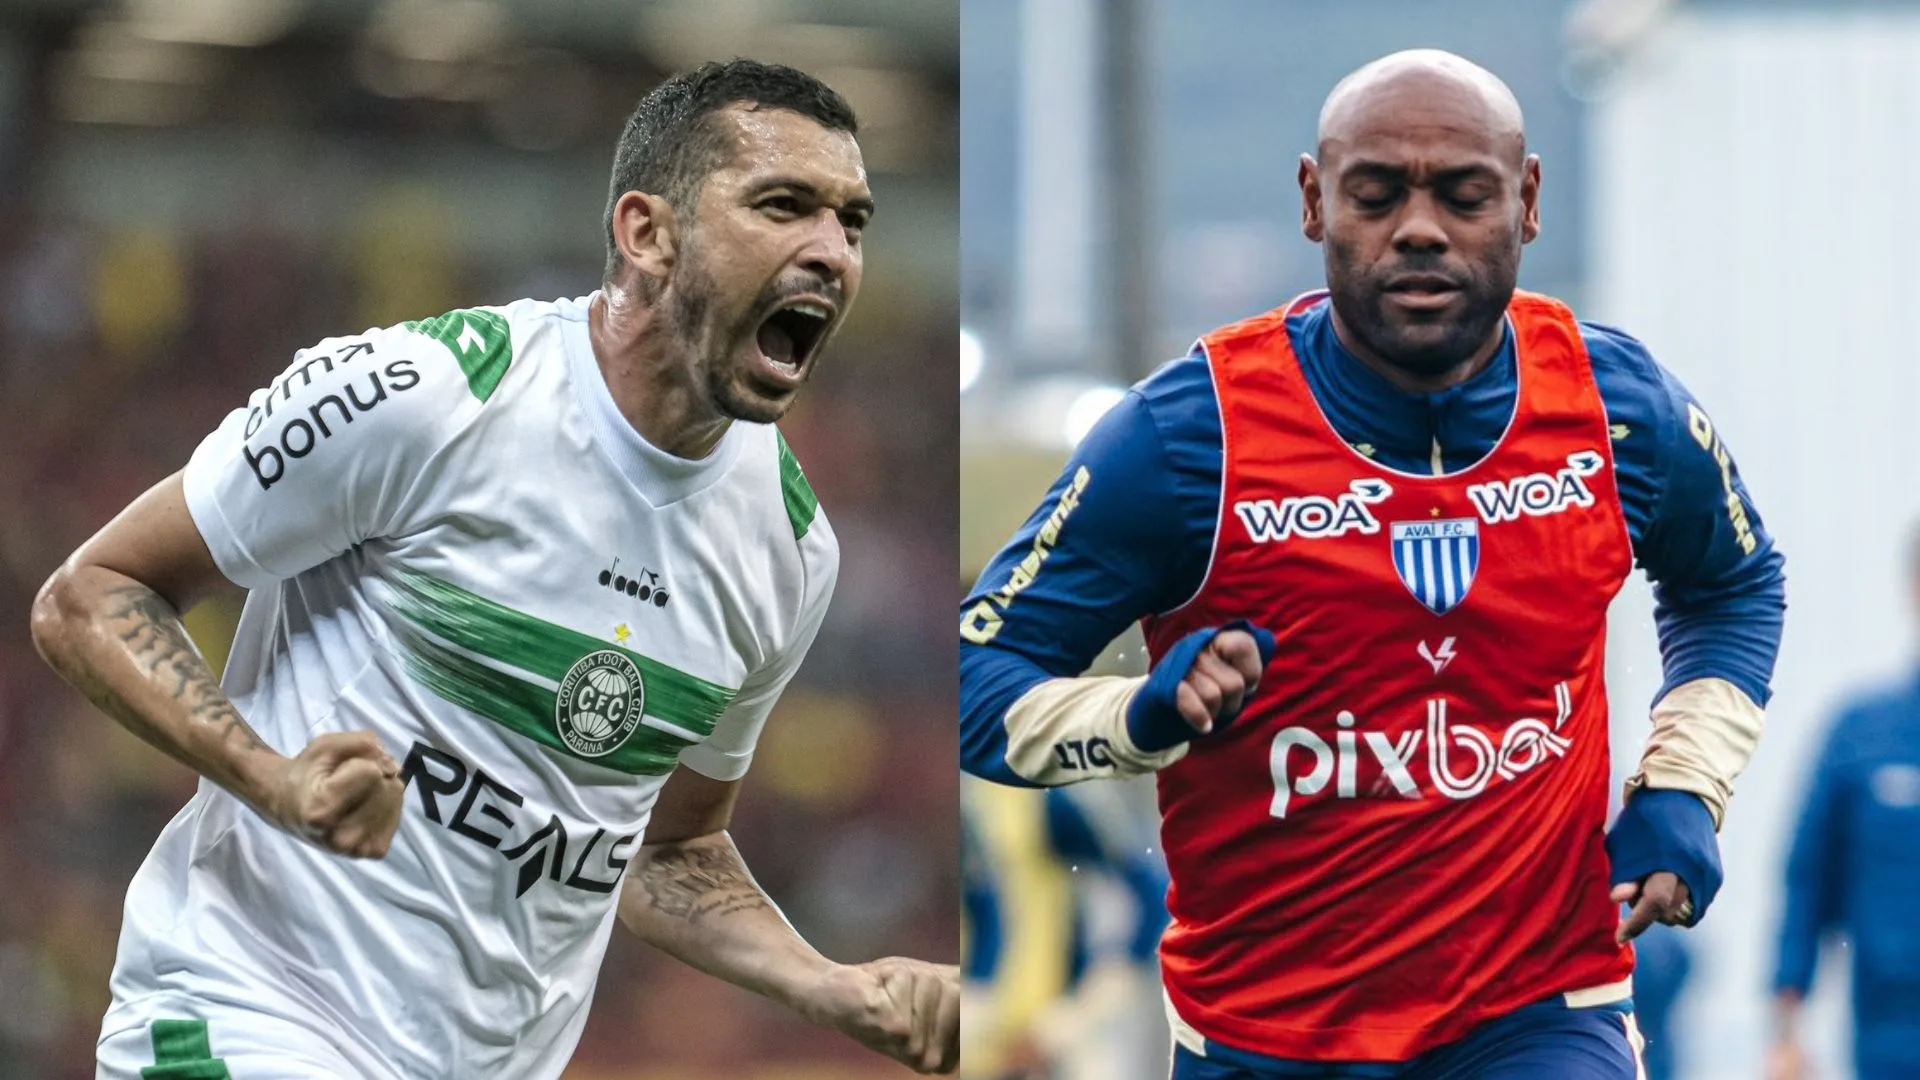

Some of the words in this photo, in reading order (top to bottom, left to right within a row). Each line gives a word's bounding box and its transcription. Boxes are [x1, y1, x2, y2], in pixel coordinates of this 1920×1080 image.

[242, 359, 420, 491] bonus
[1240, 498, 1376, 538] WOA
[1473, 472, 1589, 520] WOA
[597, 556, 671, 609] diadora
[559, 658, 596, 708] CORITIBA
[597, 653, 624, 669] FOOT
[622, 663, 641, 695] BALL
[577, 685, 624, 722] CFC
[622, 698, 642, 733] CLUB
[398, 740, 639, 899] REALS
